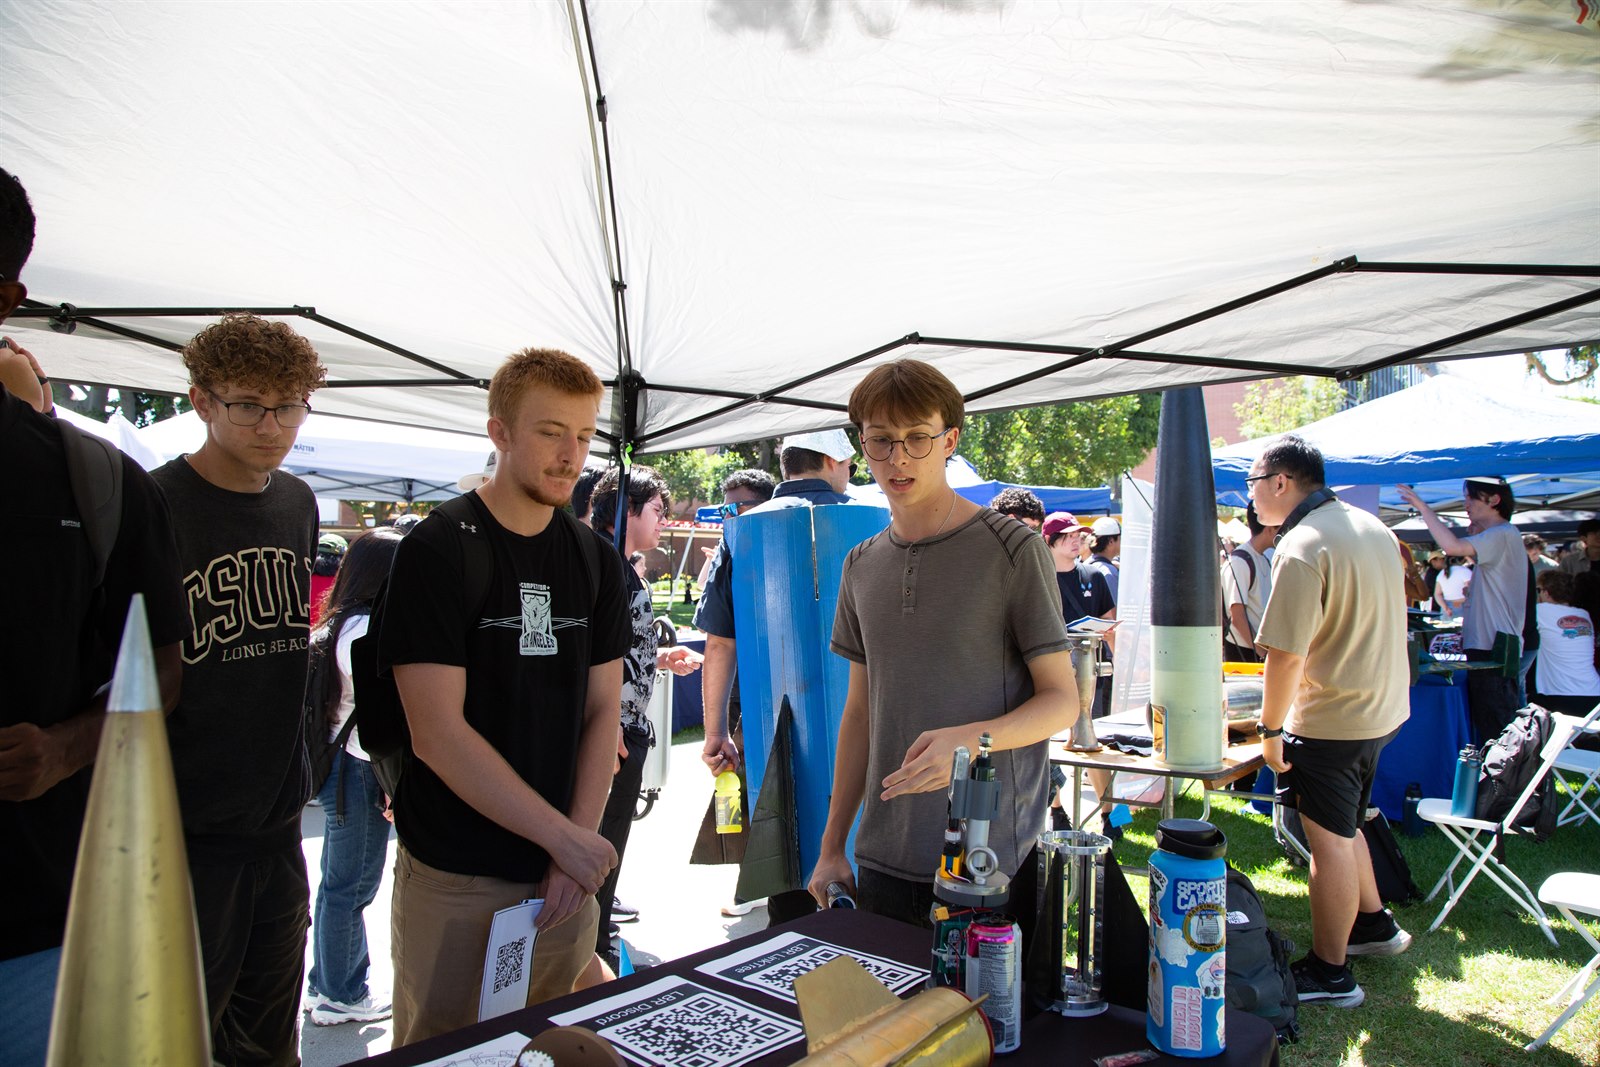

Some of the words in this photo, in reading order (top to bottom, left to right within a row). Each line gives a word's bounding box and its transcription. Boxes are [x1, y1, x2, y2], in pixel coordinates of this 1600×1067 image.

[180, 547, 312, 665] CSUL
[221, 642, 266, 662] LONG
[269, 637, 310, 654] BEAC
[782, 943, 809, 956] LBR
[651, 990, 685, 1006] LBR
[1173, 987, 1187, 1000] IN
[595, 1003, 653, 1026] Discord
[1173, 1002, 1187, 1047] WOMEN
[1187, 988, 1201, 1049] ROBOTICS
